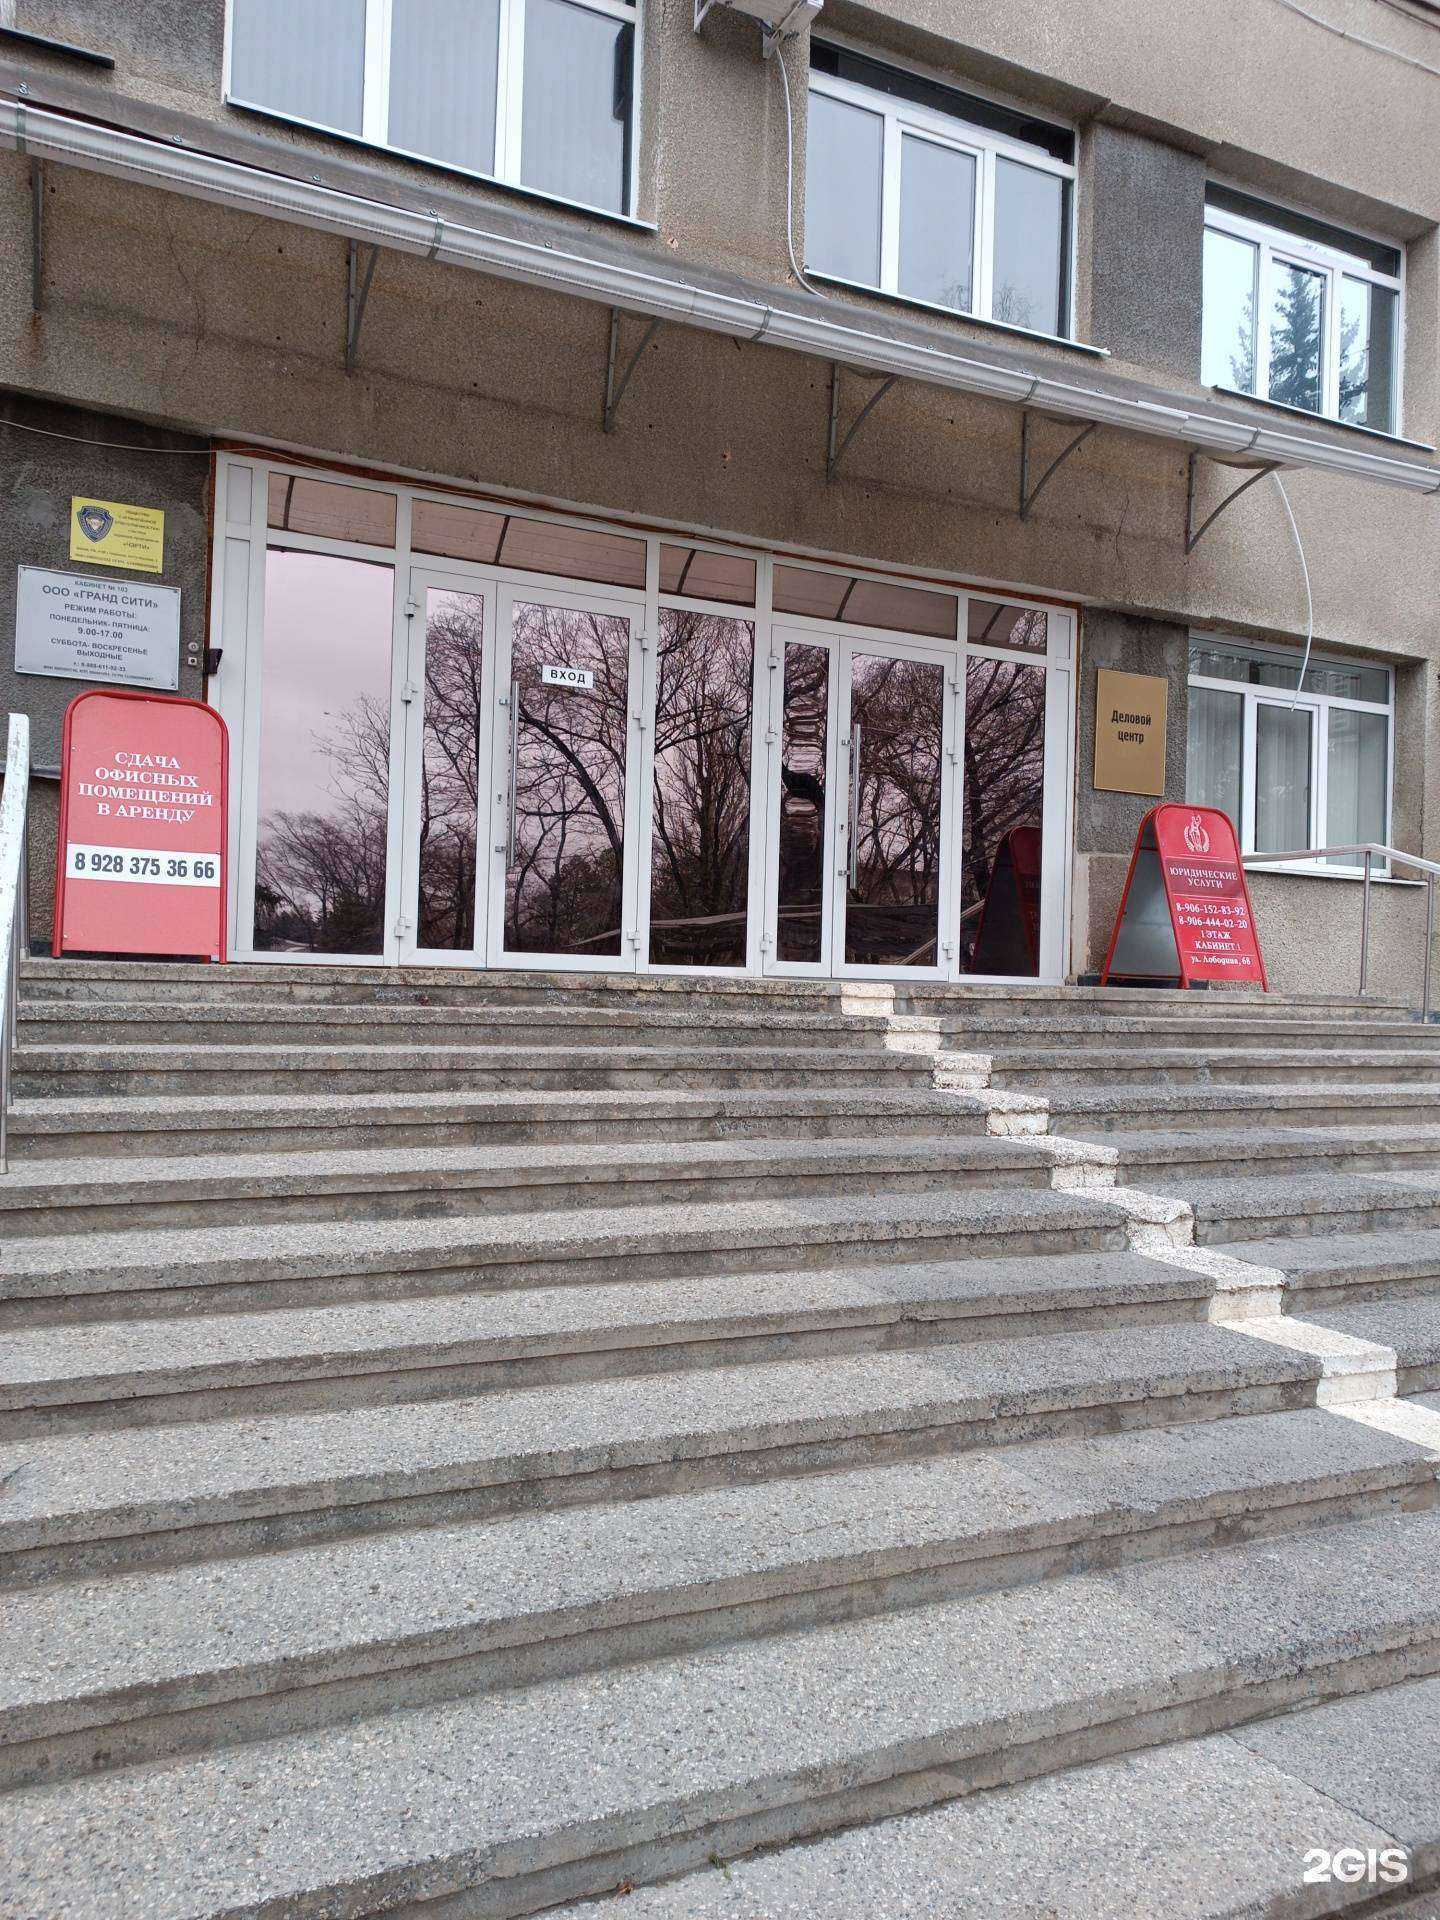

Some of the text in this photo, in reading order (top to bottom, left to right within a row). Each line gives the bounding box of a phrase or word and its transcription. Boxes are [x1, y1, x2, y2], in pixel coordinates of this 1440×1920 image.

[74, 580, 106, 589] КАБИНЕТ
[42, 585, 159, 608] ООО «ГРАНД СИТИ»
[64, 603, 137, 619] РЕЖИМ РАБОТЫ:
[77, 627, 123, 640] 9.00-17.00
[76, 649, 123, 661] ВЫХОДНЫЕ
[92, 642, 149, 656] ВОСКРЕСЕНЬЕ
[550, 669, 586, 684] ВХОД
[1111, 710, 1152, 726] Деловой
[1118, 731, 1145, 745] центр
[114, 752, 181, 769] СДАЧА
[95, 768, 199, 788] ОФИСНЫХ
[78, 783, 213, 806] ПОМЕЩЕНИЙ
[96, 803, 195, 824] В АРЕНДУ
[75, 852, 215, 879] 8 928 375 36 66
[1169, 867, 1238, 881] ЮРИДИЧЕСКИЕ
[1188, 877, 1223, 888] УСЛУГИ
[1176, 903, 1245, 916] 8-906-152-83-92
[1206, 930, 1232, 940] ЭТАЖ
[1194, 940, 1236, 951] КАБИНЕТ
